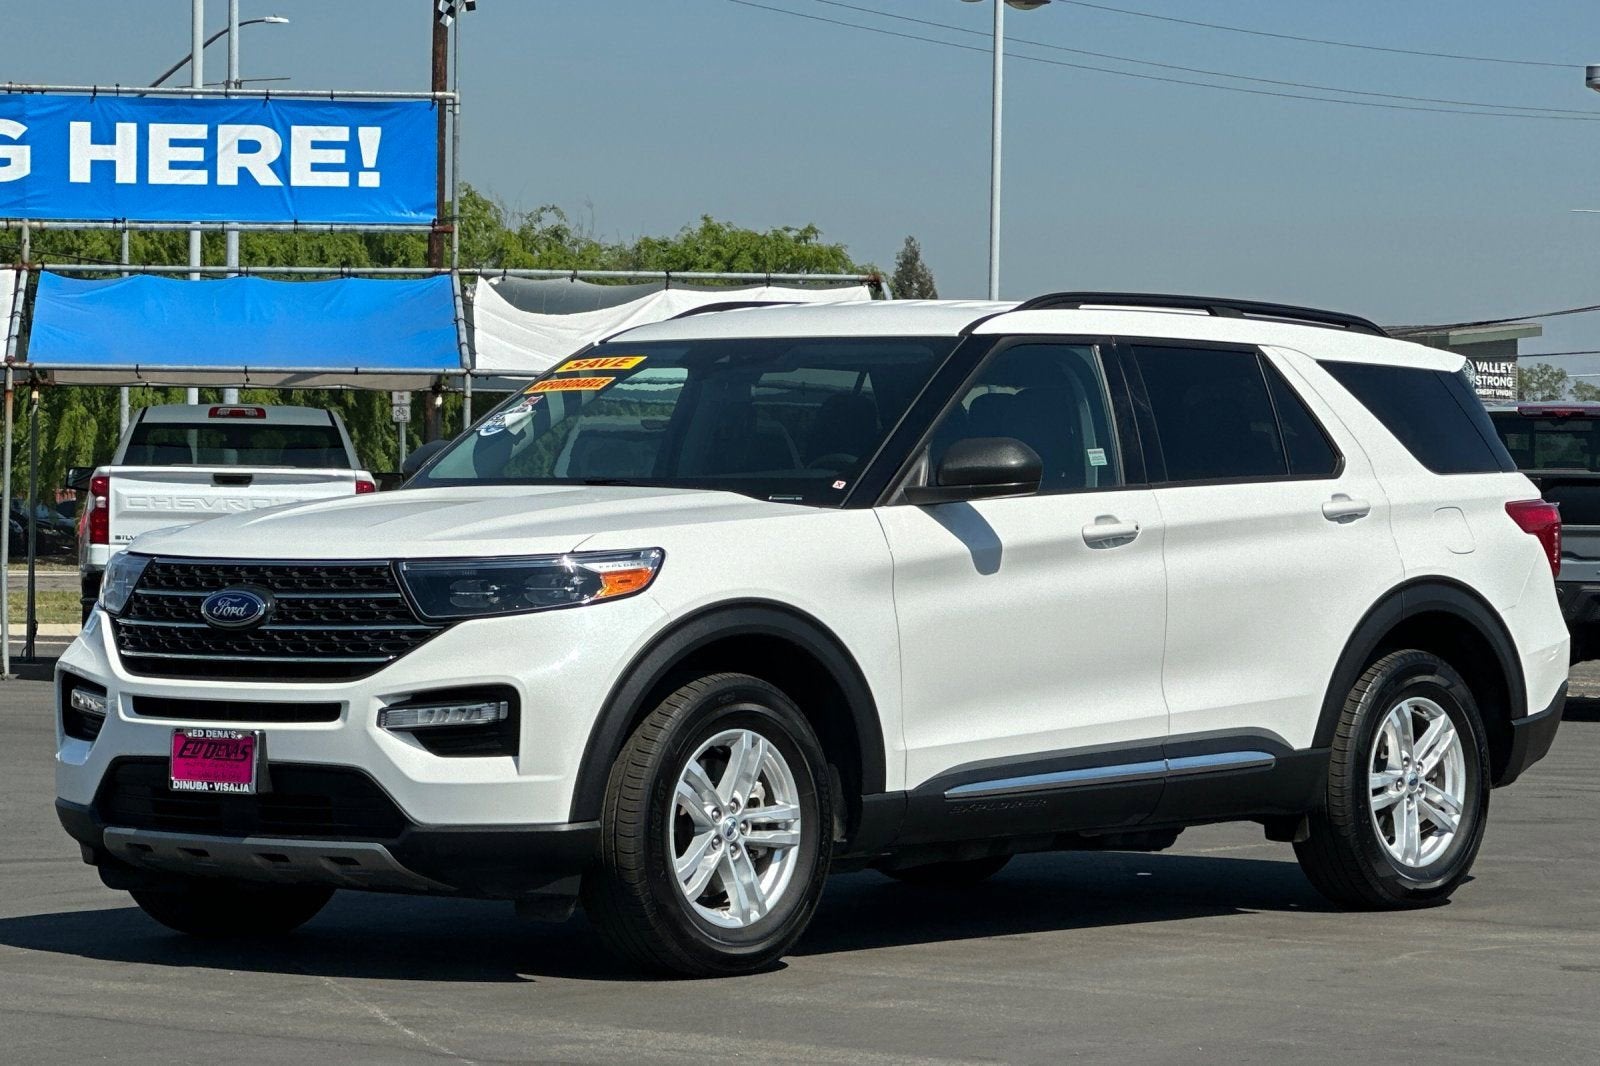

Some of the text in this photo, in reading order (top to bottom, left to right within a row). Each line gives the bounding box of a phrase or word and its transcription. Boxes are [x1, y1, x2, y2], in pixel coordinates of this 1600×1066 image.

[69, 121, 382, 187] HERE!
[566, 358, 634, 369] SAVE
[1475, 361, 1513, 373] VALLEY
[1475, 375, 1513, 387] STRONG
[1475, 389, 1513, 397] CREDIT UNION
[213, 597, 249, 617] Ford
[192, 729, 236, 739] ED DENA'S
[172, 780, 250, 793] DINUBA VISALIA
